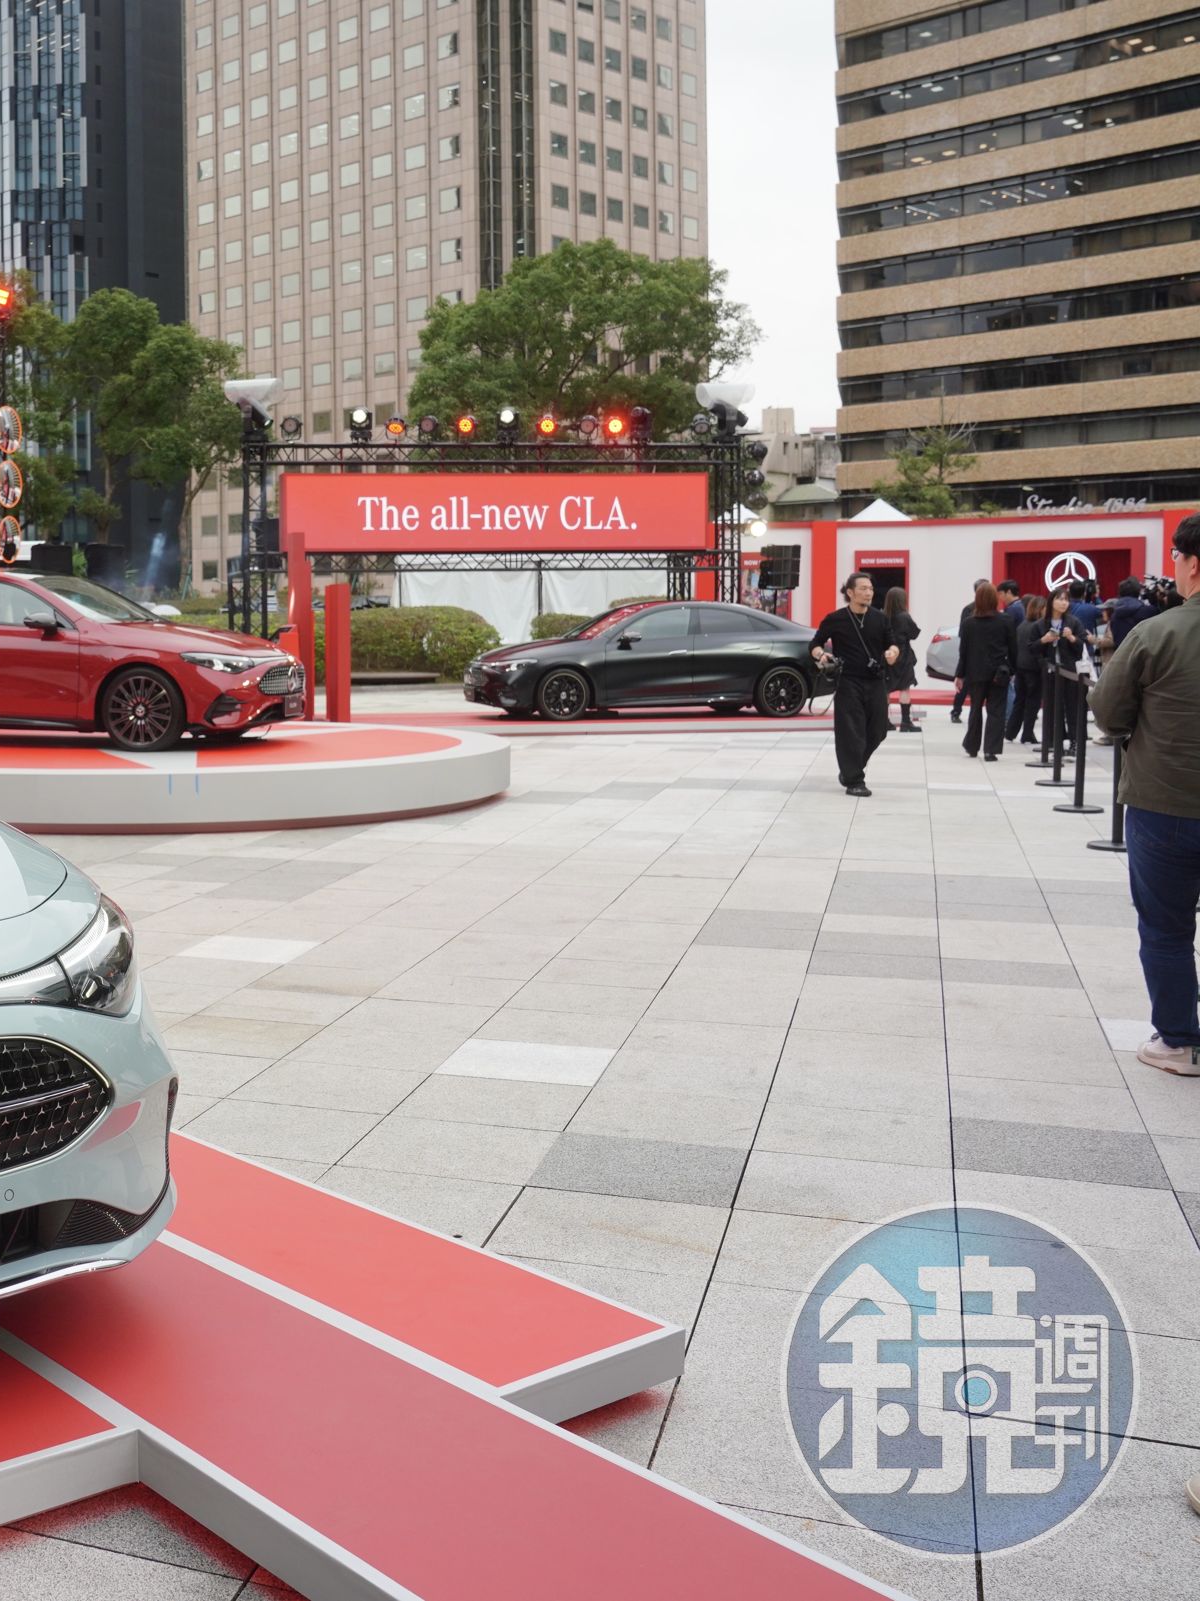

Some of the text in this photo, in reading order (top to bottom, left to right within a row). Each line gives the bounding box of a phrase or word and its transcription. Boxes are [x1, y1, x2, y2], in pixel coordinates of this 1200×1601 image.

[357, 495, 639, 531] The all-new CLA.
[1016, 494, 1094, 517] Studio
